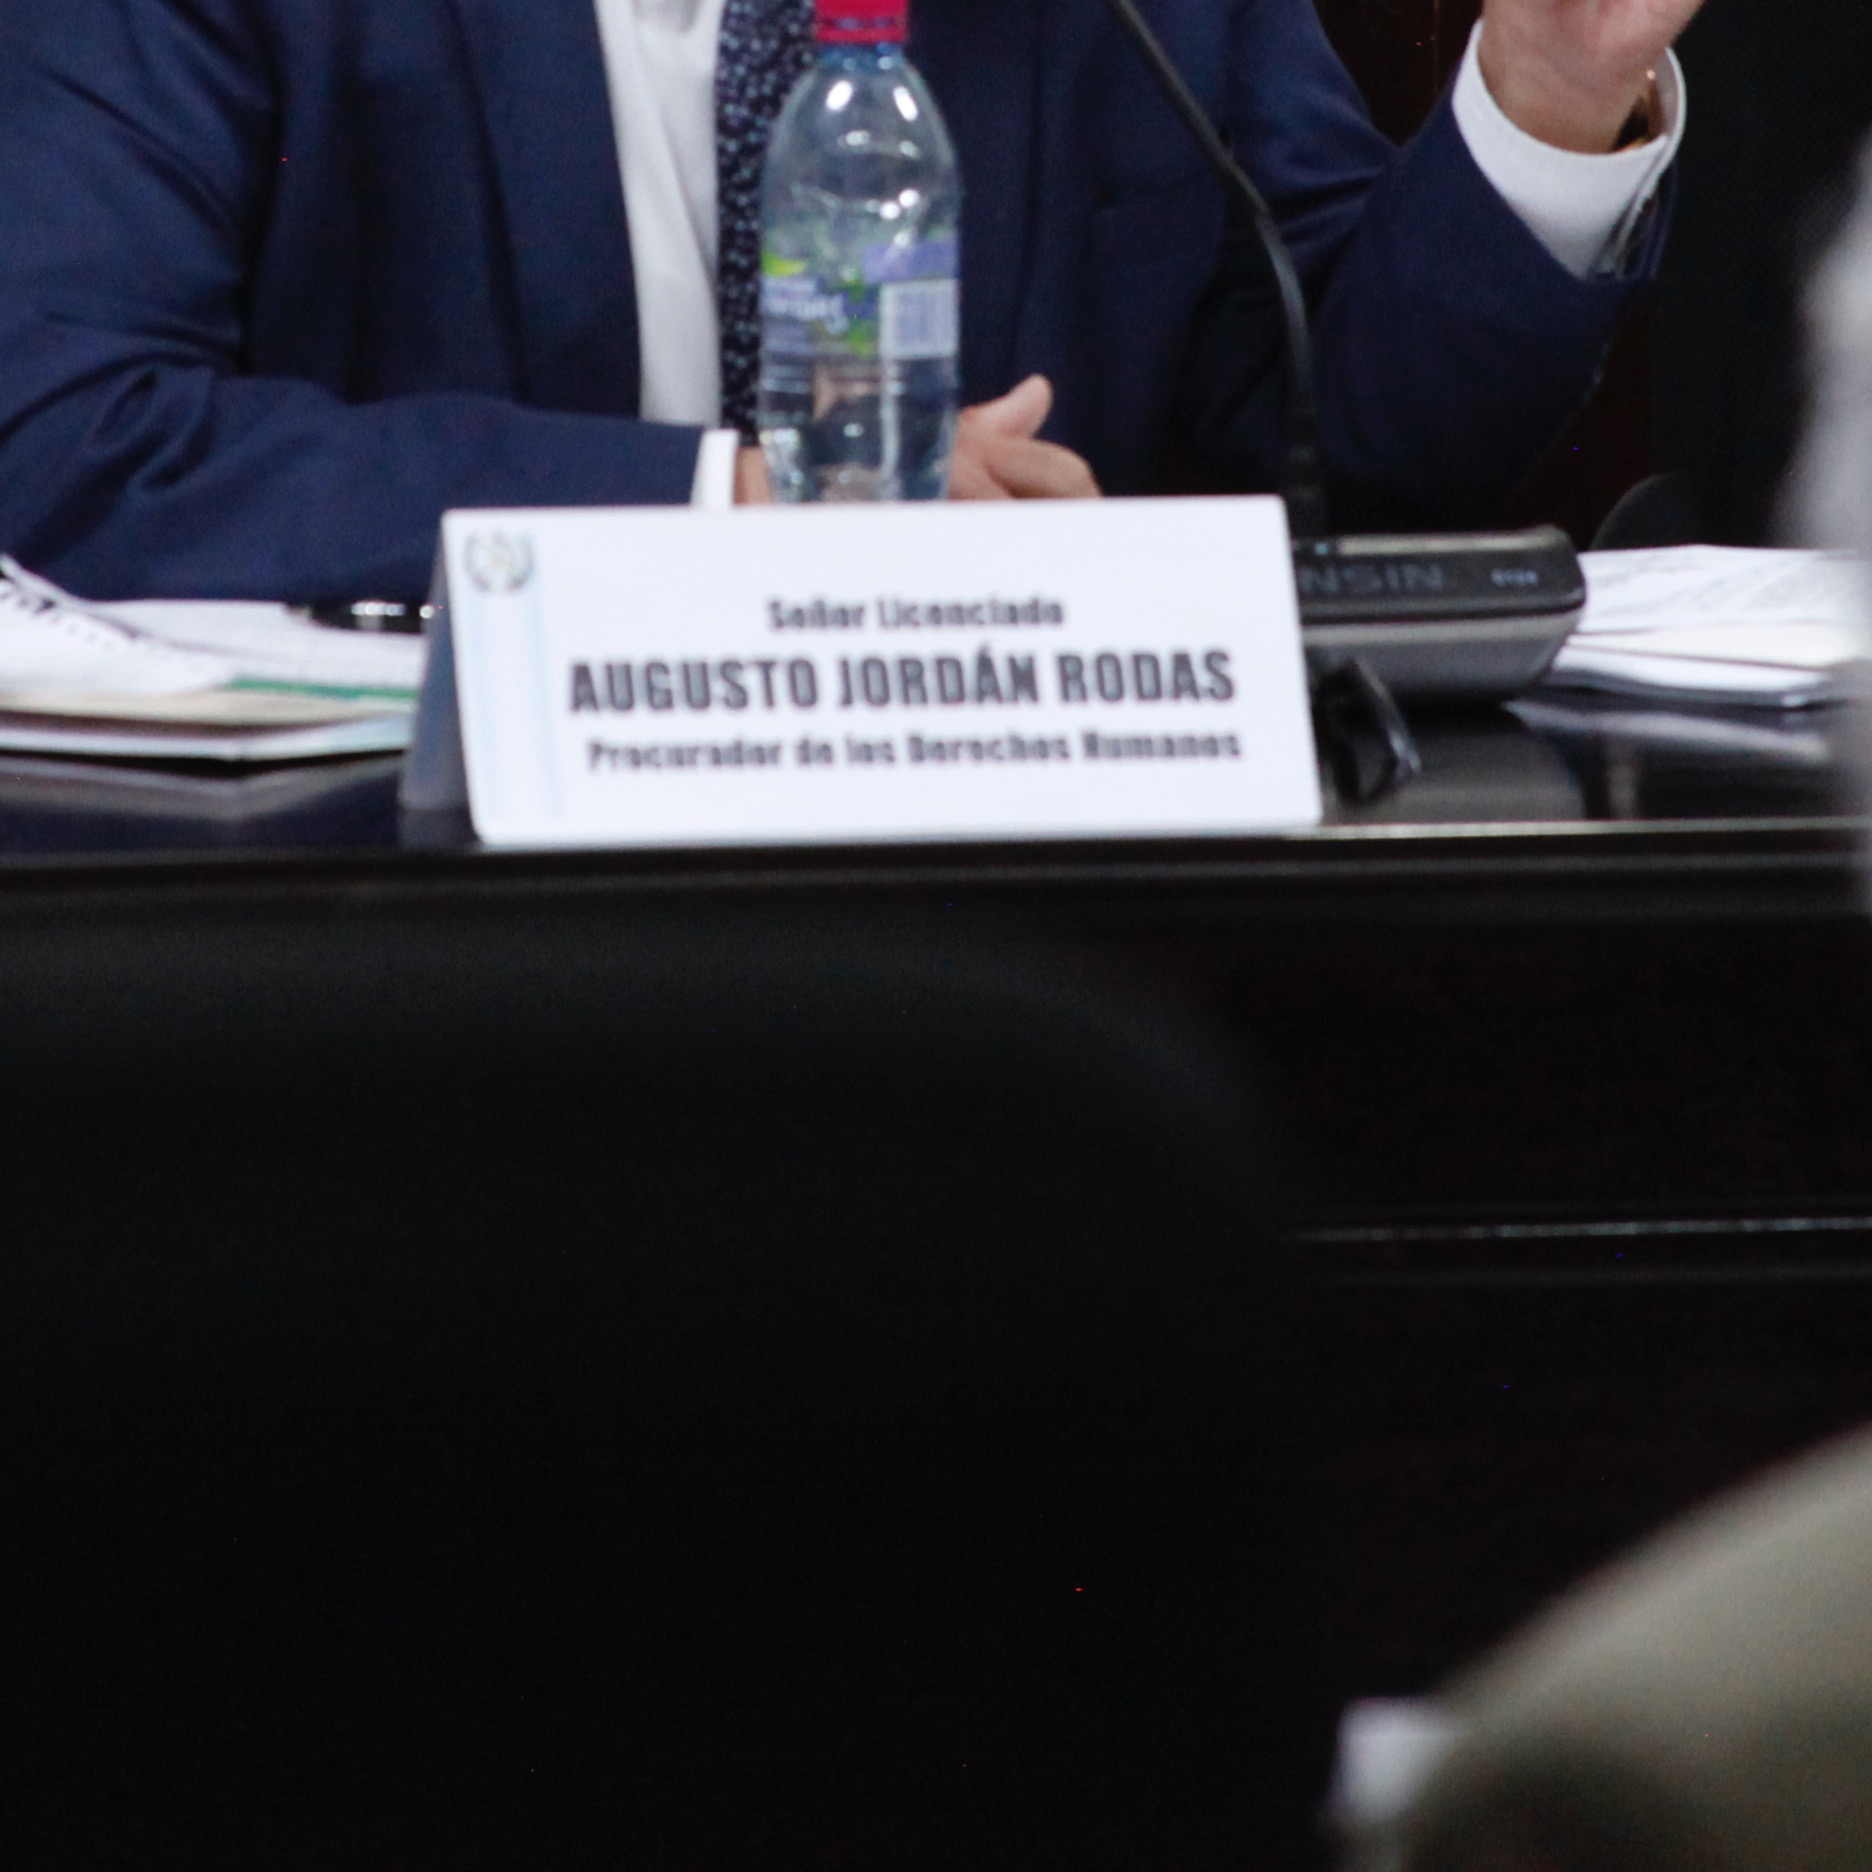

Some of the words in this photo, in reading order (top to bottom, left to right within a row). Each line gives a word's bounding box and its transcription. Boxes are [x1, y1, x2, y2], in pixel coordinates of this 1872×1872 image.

[1297, 563, 1444, 593] NSIN
[766, 598, 864, 629] Señor
[878, 598, 1065, 628] Licenciado
[569, 658, 820, 712] AUGUSTO
[837, 642, 1040, 709] JORDÁN
[1056, 650, 1236, 704] RODAS
[588, 739, 781, 771] Procurador
[796, 736, 835, 766] de
[845, 735, 896, 766] los
[905, 732, 1071, 763] Derechos
[1080, 729, 1242, 760] Humanos
